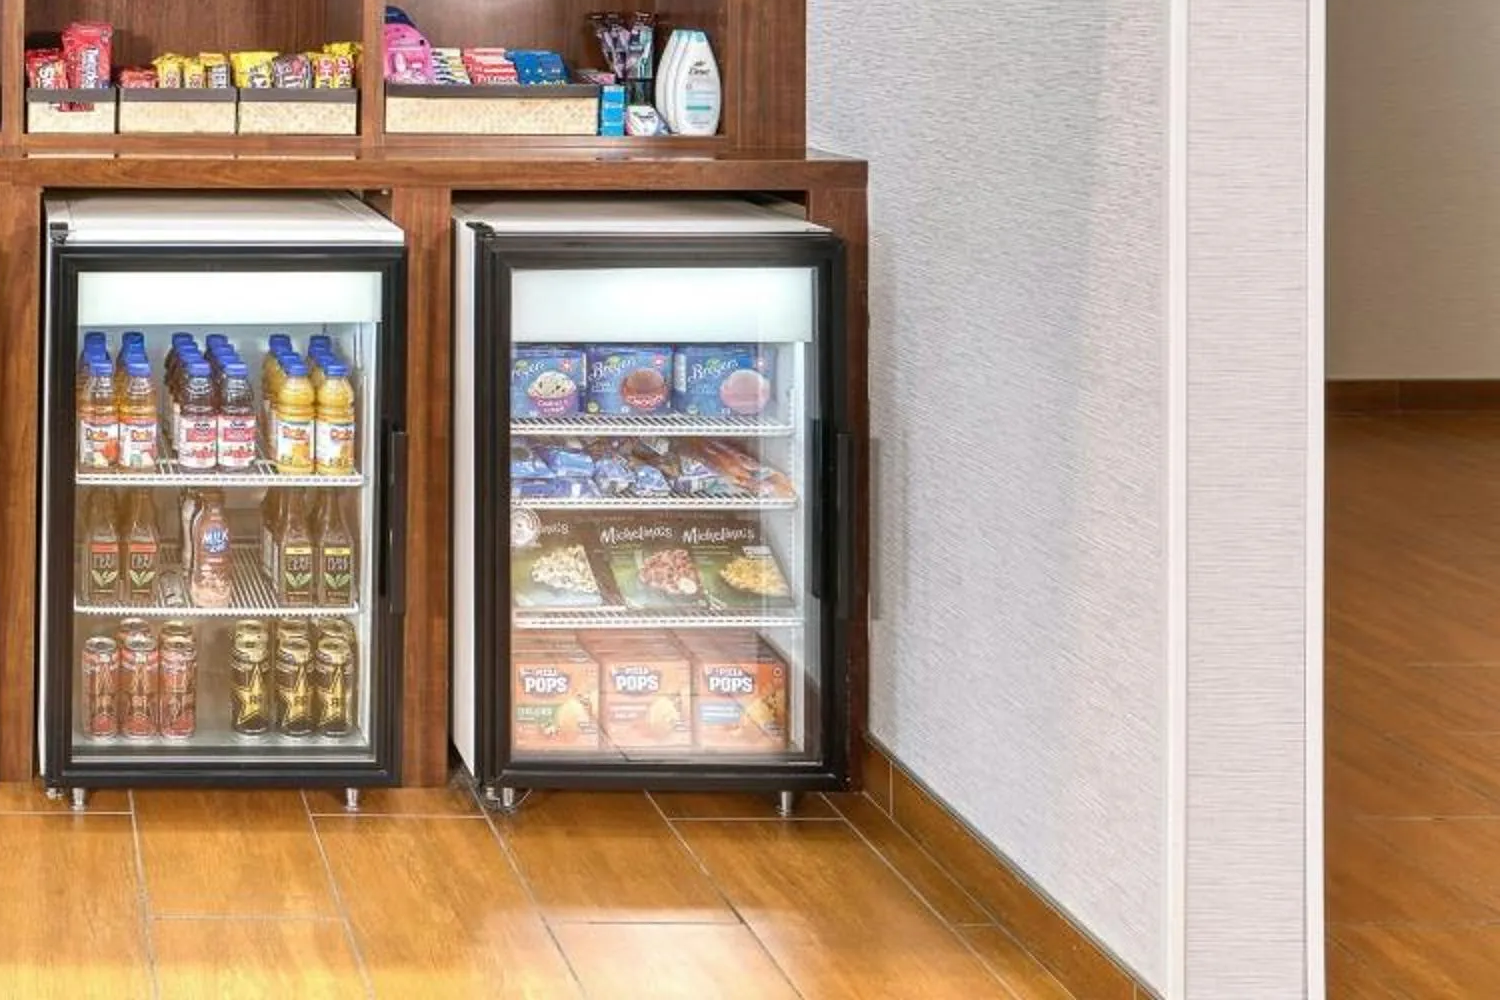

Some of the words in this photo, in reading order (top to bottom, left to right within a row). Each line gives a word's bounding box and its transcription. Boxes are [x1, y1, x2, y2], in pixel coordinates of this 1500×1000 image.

[524, 677, 569, 693] POPS
[615, 675, 660, 690] POPS
[708, 677, 753, 693] POPS
